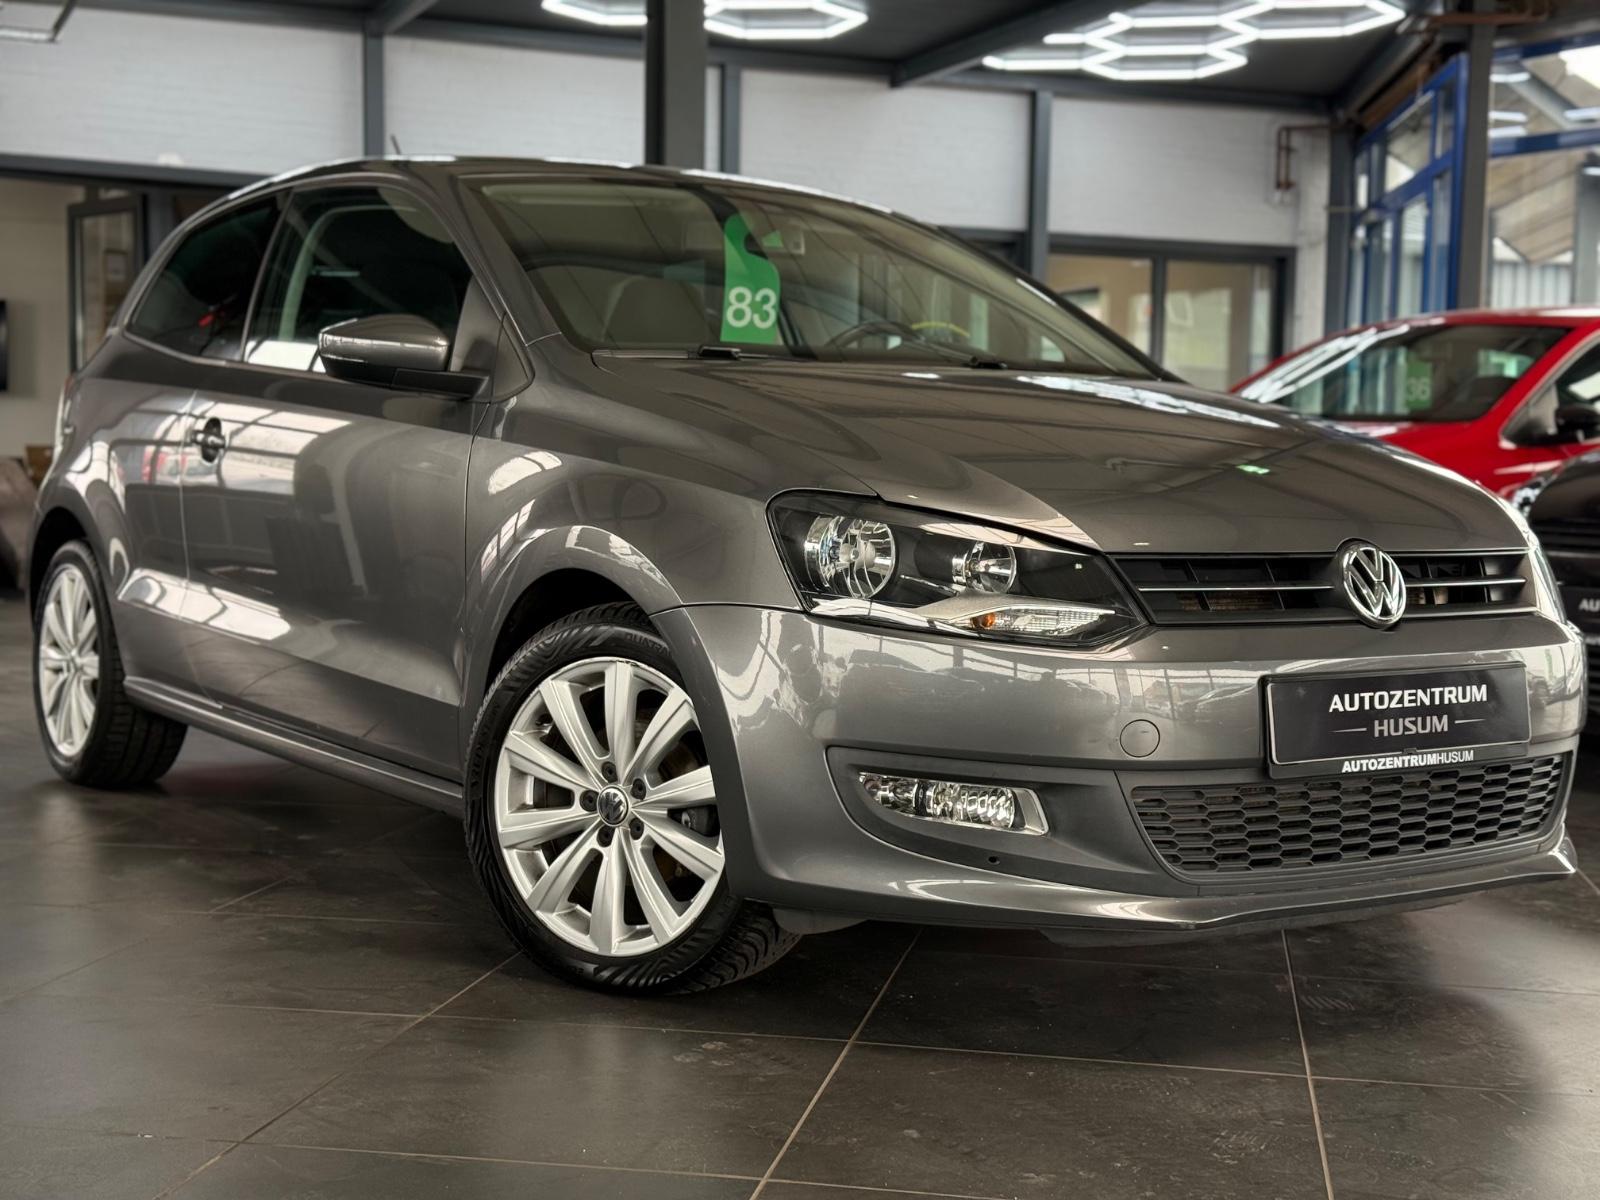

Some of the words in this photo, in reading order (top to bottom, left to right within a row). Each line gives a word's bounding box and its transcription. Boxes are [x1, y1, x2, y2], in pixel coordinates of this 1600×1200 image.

[726, 286, 777, 329] 83
[1328, 684, 1488, 713] AUTOZENTRUM
[1374, 714, 1448, 738] HUSUM
